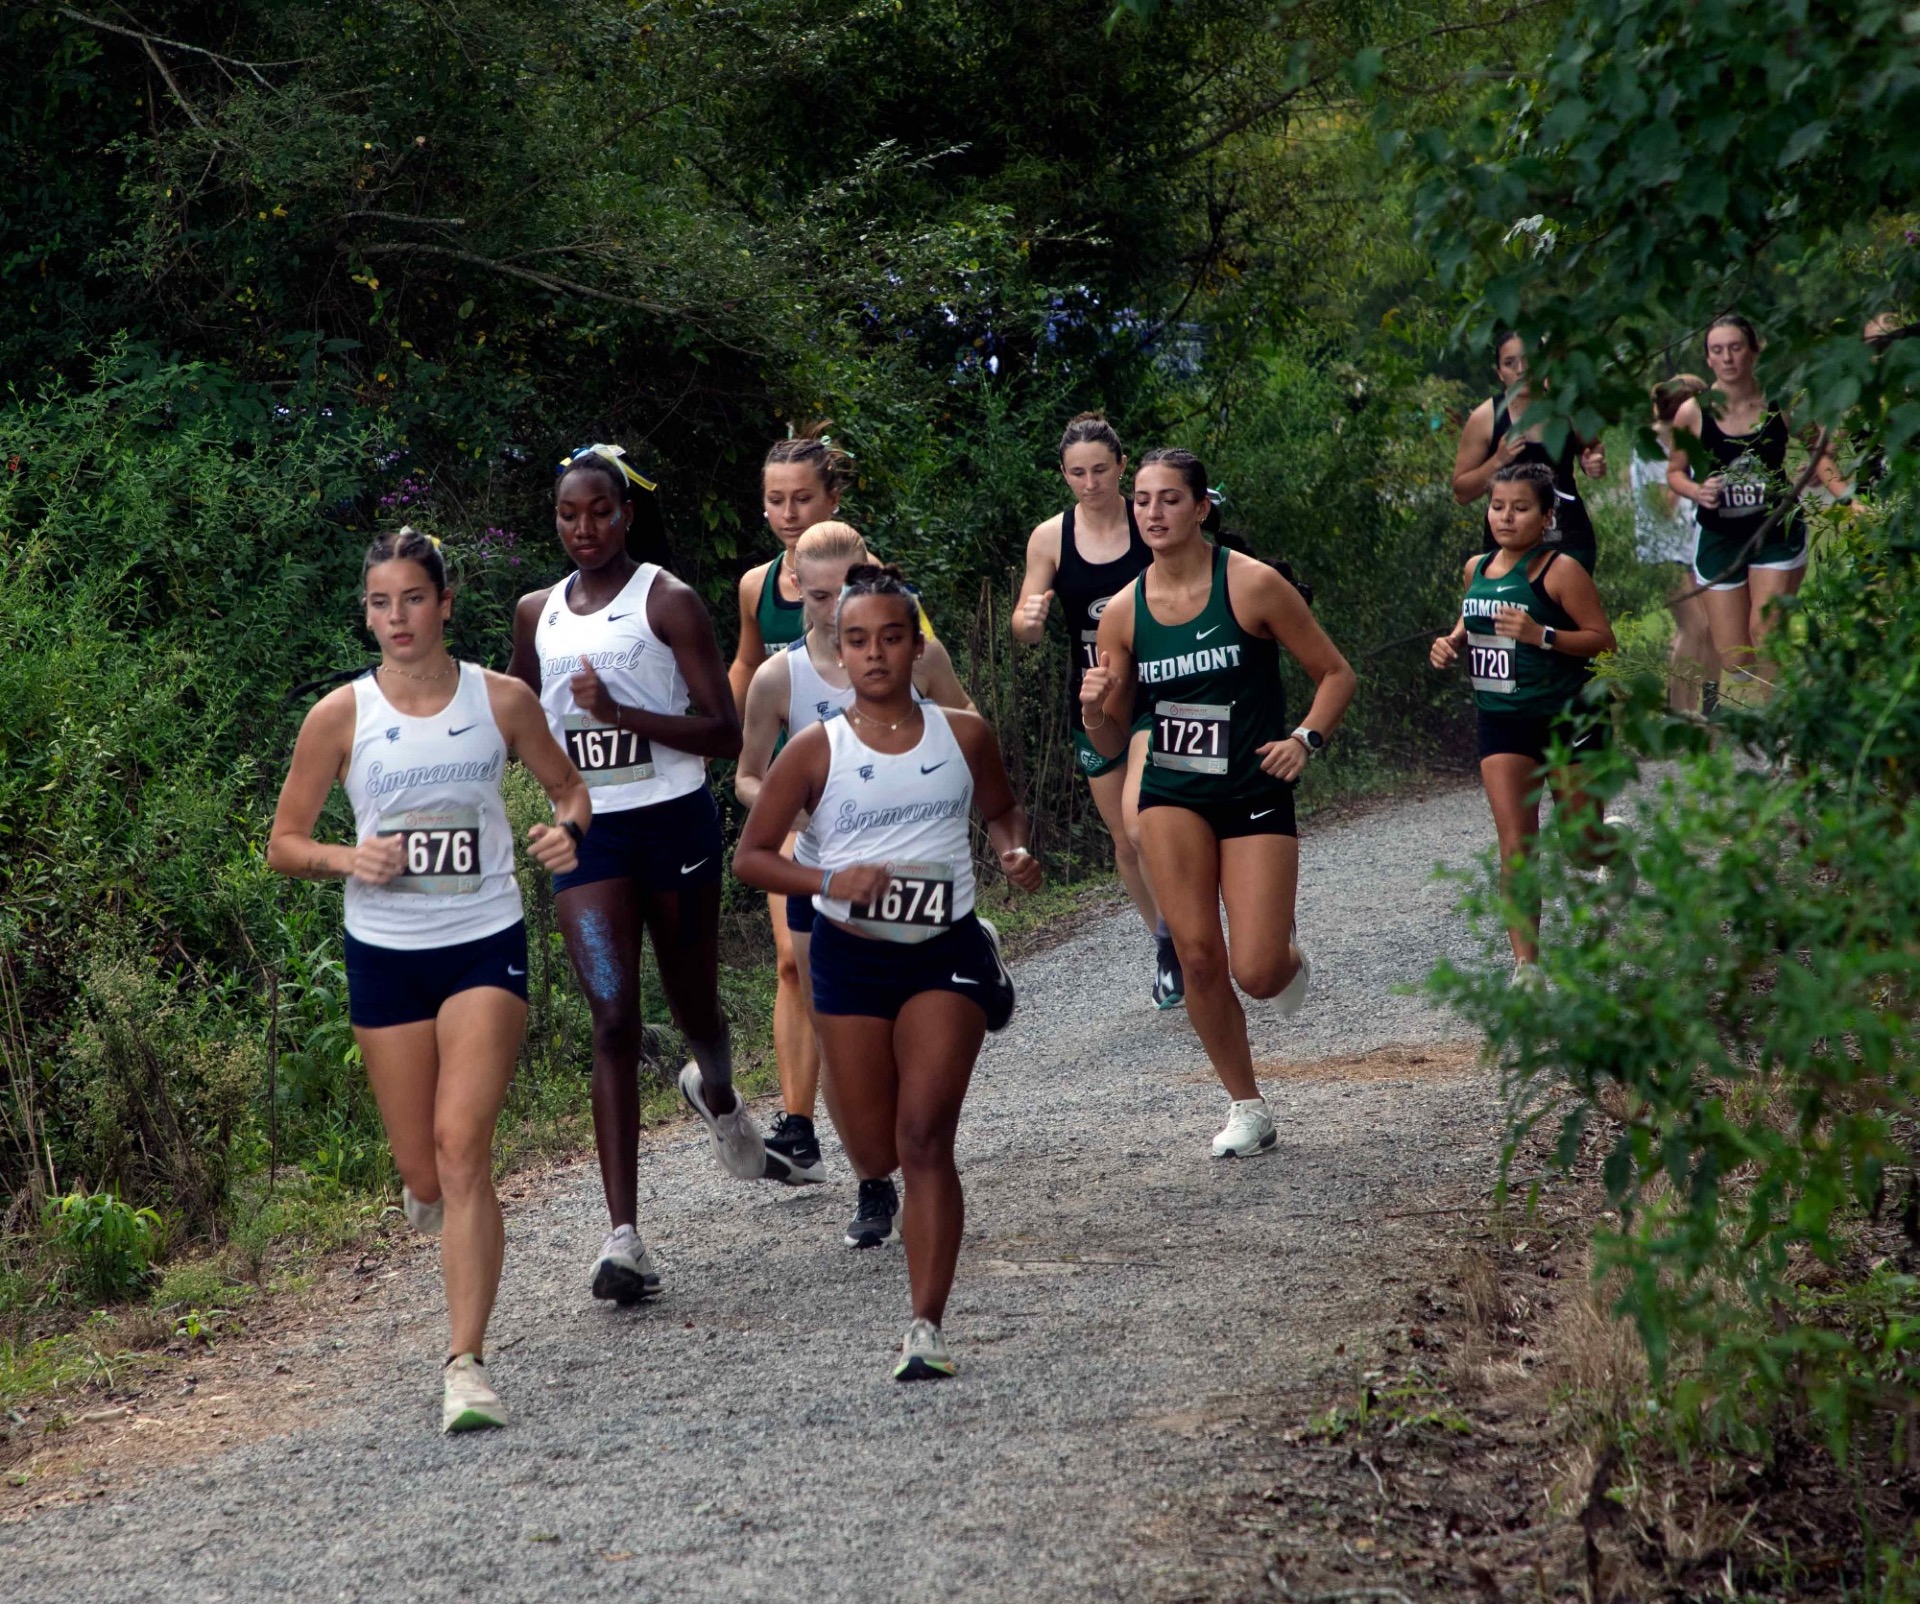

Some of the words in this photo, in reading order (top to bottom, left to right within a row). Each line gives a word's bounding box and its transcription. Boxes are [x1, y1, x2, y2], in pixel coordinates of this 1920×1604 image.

[541, 640, 646, 681] mmanuel
[1470, 648, 1509, 679] 1720
[571, 729, 638, 768] 1677
[1159, 718, 1219, 756] 1721
[365, 750, 500, 798] Emmanuel
[835, 785, 970, 834] Emmanuel
[407, 830, 473, 875] 676
